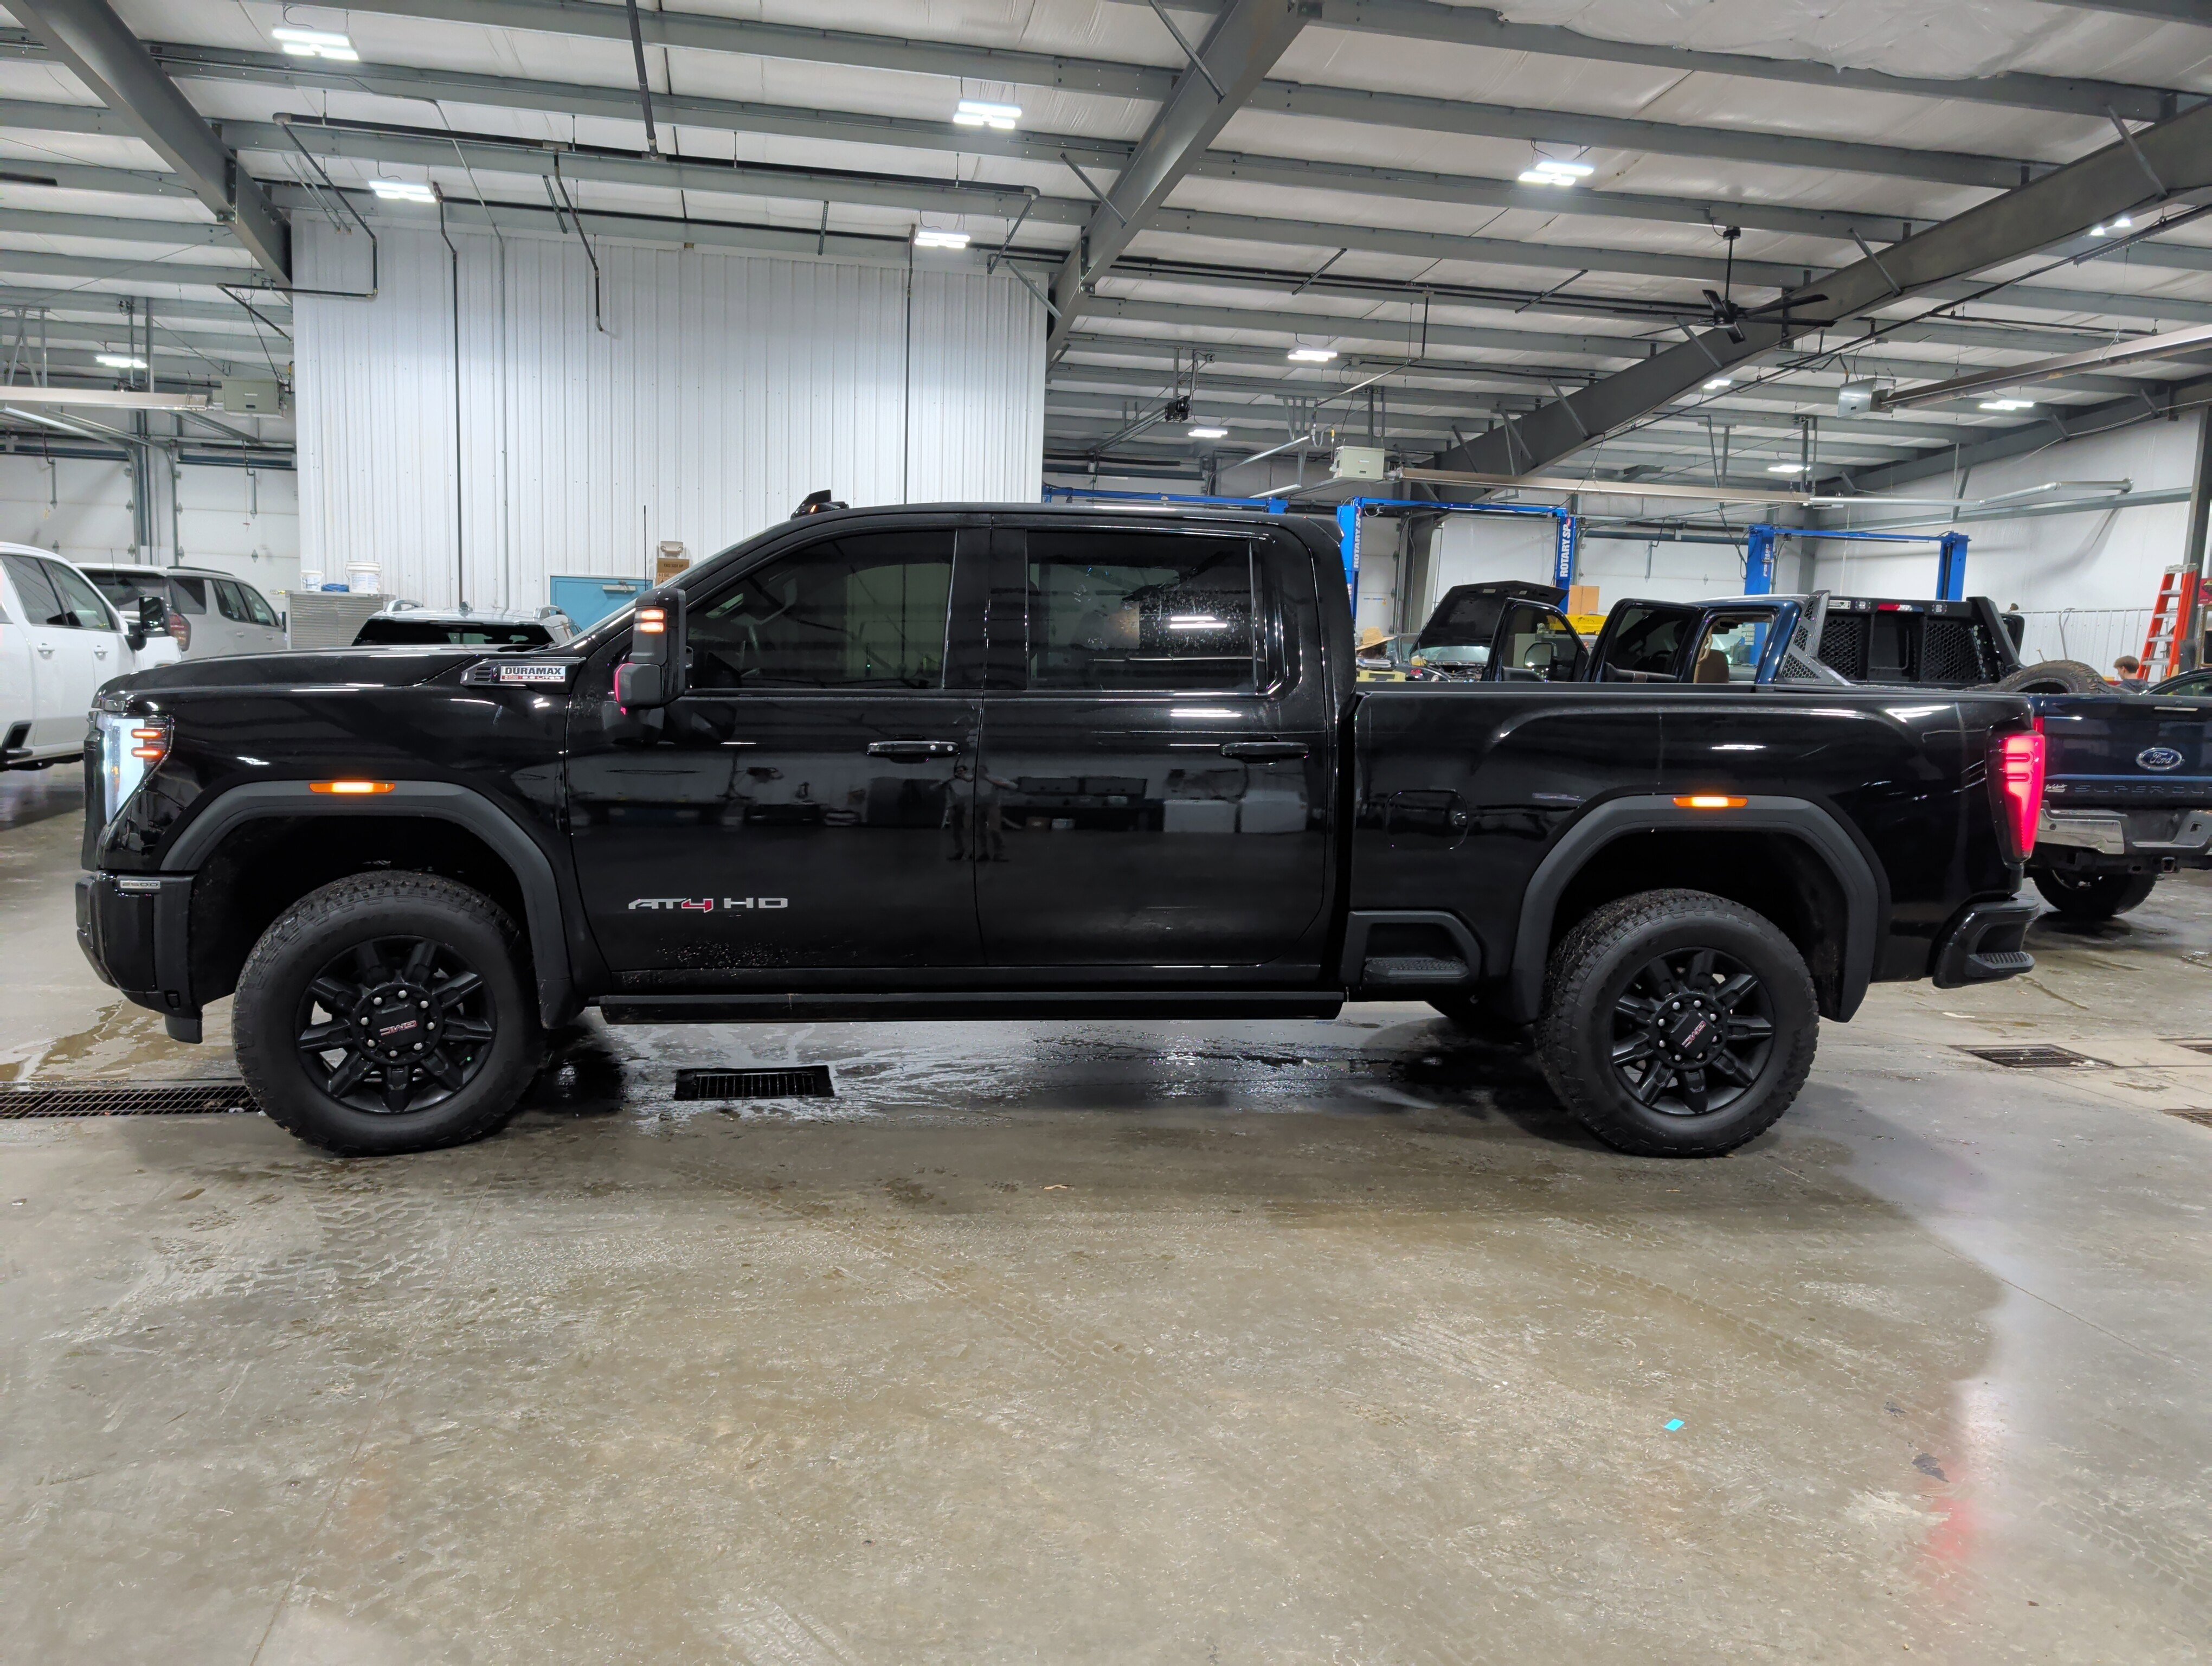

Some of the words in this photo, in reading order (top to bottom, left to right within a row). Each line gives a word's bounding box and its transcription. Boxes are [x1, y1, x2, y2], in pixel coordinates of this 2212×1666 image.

[1560, 539, 1570, 578] ROTARY
[2149, 752, 2174, 764] Ford
[2074, 785, 2164, 794] SUPER
[628, 898, 714, 913] AT4
[724, 898, 788, 909] HD
[380, 1020, 417, 1036] GMC
[1681, 1020, 1707, 1048] GMC
